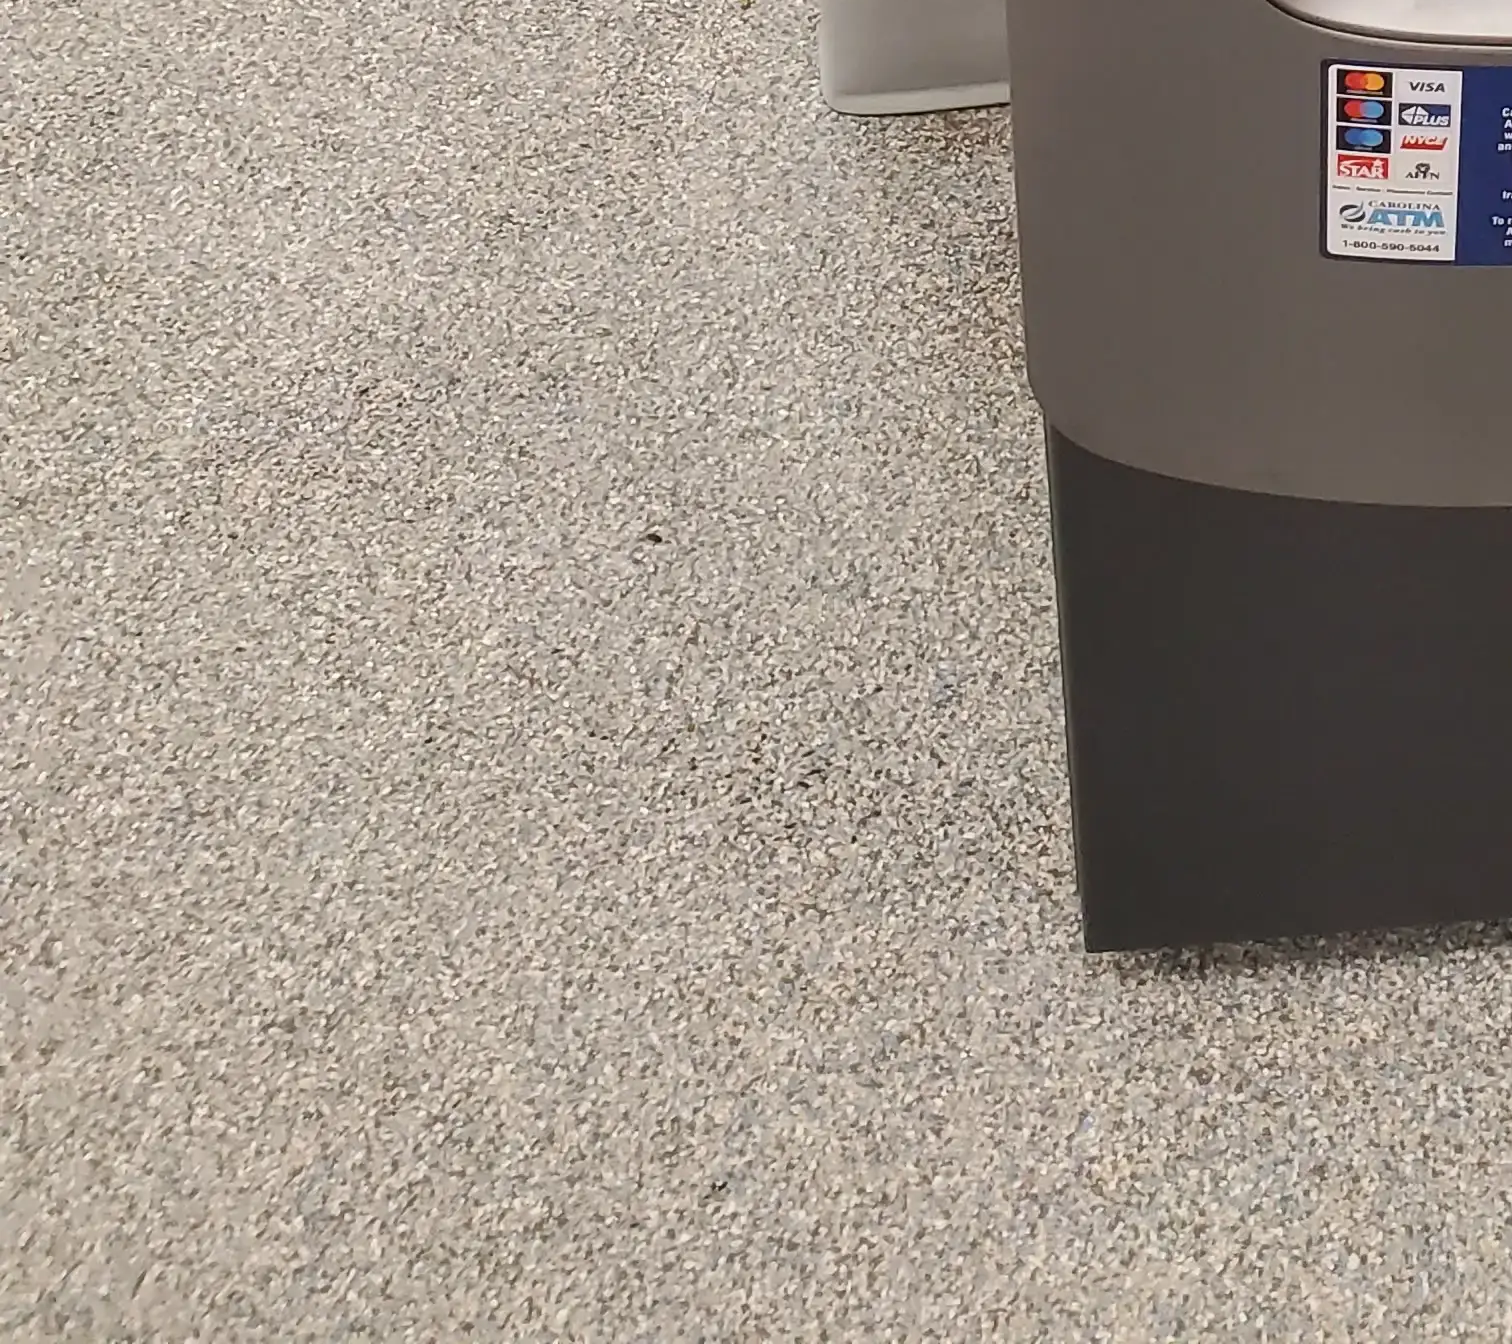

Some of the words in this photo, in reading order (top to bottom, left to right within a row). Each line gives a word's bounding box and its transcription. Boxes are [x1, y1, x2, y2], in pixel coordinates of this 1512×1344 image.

[1409, 80, 1445, 93] VISA
[1413, 115, 1449, 126] PLUS
[1339, 163, 1385, 179] STAR
[1368, 200, 1440, 211] CAROLINA
[1366, 208, 1445, 228] ATM
[1491, 216, 1504, 225] To
[1342, 239, 1440, 252] 1-800-590-5044
